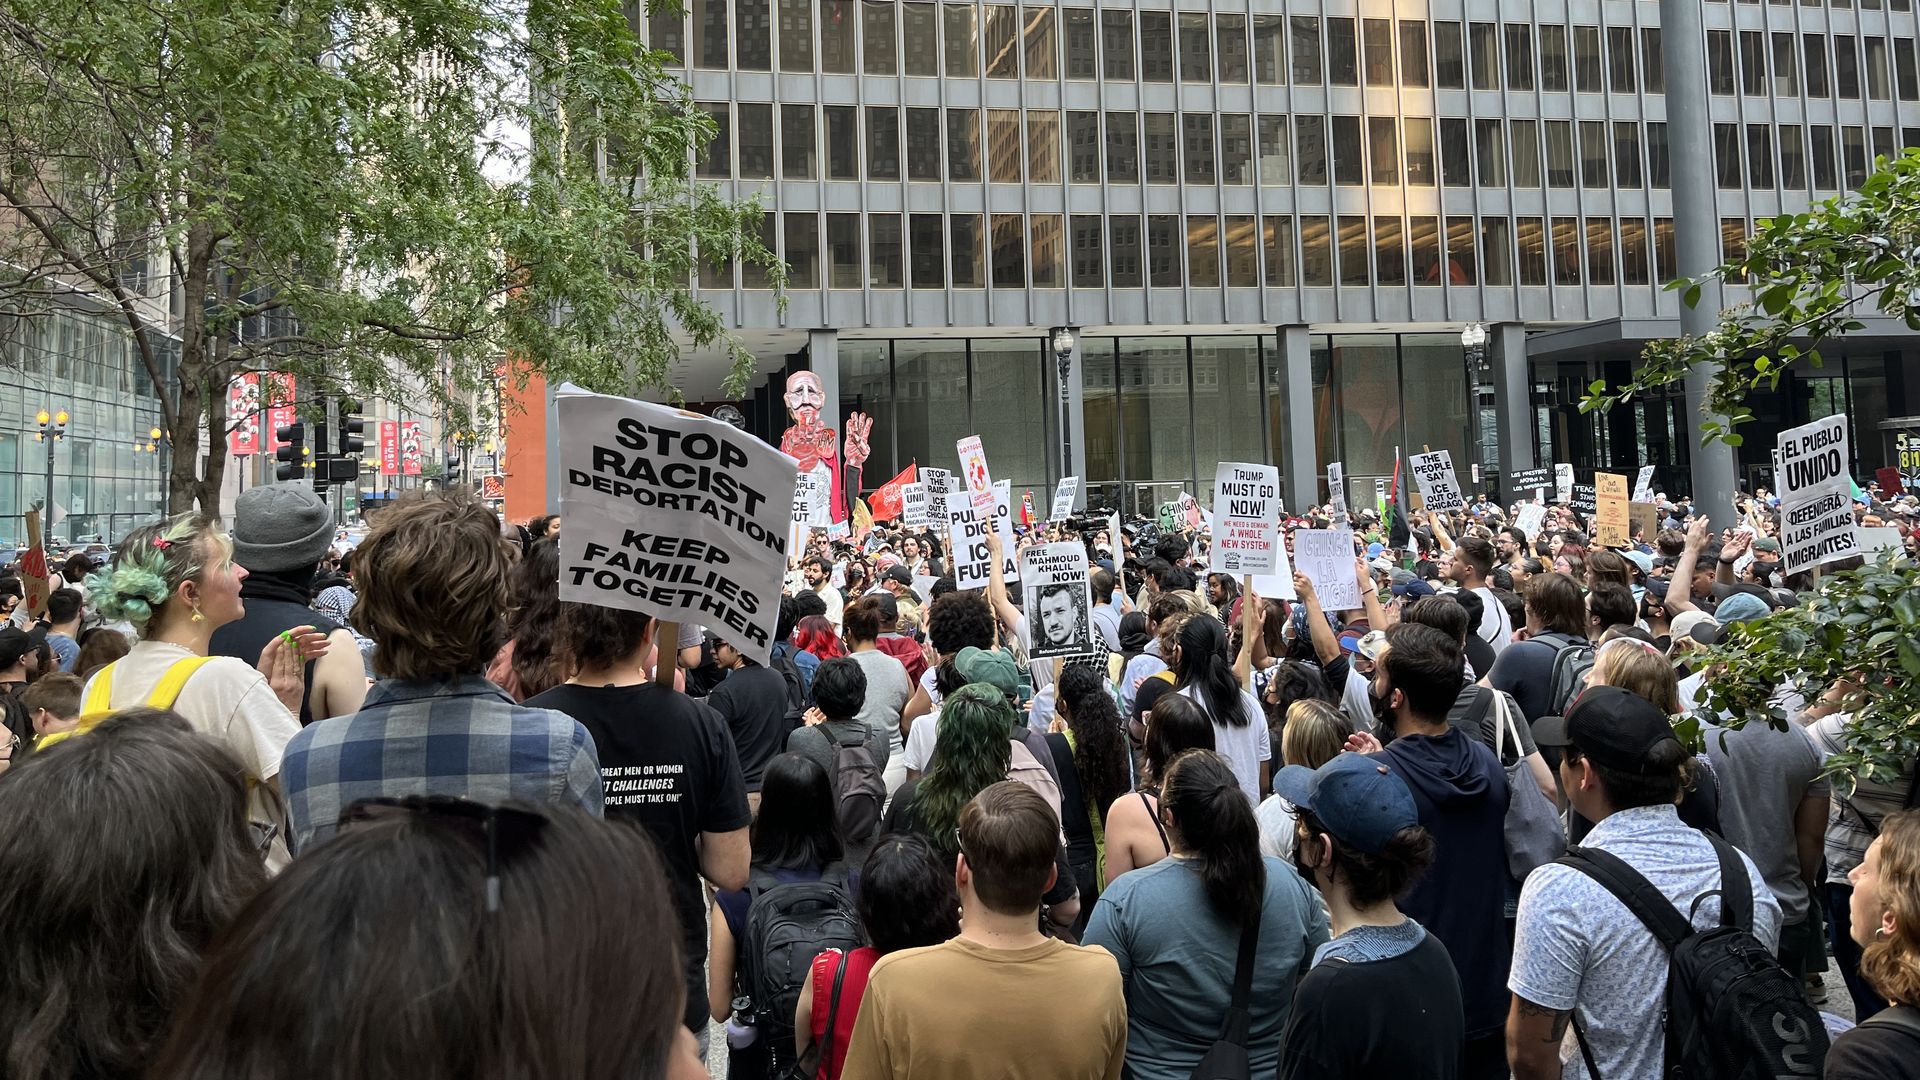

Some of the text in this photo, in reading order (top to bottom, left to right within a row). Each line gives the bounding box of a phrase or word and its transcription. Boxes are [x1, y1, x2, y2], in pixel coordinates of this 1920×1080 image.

[615, 417, 748, 470] STOP
[1782, 439, 1800, 463] ¡EL
[1802, 425, 1842, 454] PUEBLO
[1420, 454, 1440, 464] THE
[1414, 461, 1451, 474] PEOPLE
[1786, 448, 1841, 492] UNIDO
[927, 470, 946, 478] STOP
[1234, 469, 1264, 482] TRUMP
[1426, 471, 1445, 482] SAY
[592, 445, 766, 517] RACIST
[930, 478, 944, 486] THE
[795, 490, 807, 498] AY
[928, 486, 948, 494] RAIDS
[1222, 482, 1274, 498] MUST GO
[1431, 484, 1450, 494] ICE
[906, 493, 924, 503] UNI
[932, 496, 946, 506] ICE
[1427, 492, 1458, 503] OUT OF
[568, 468, 786, 555] DEPORTATION
[792, 502, 808, 512] CE
[928, 504, 941, 512] OUT
[1160, 499, 1200, 516] CHINGA
[1230, 500, 1265, 516] NOW!
[1426, 500, 1463, 511] CHICAGO
[1790, 492, 1842, 526] DEFENDERÁ
[792, 513, 810, 522] UT
[1230, 529, 1262, 539] A WHOLE
[1786, 512, 1851, 546] A LAS FAMILIAS
[620, 528, 731, 564] KEEP
[1222, 540, 1270, 550] NEW SYSTEM!
[1304, 532, 1351, 558] CHINGA
[1787, 532, 1855, 569] MIGRANTES!
[969, 542, 989, 562] IC
[1026, 549, 1048, 558] FREE
[1029, 554, 1080, 566] MAHMOUD
[958, 558, 1016, 582] FUEA
[1038, 564, 1074, 572] KHALIL
[1317, 558, 1337, 583] LA
[582, 542, 760, 615] FAMILIES
[1052, 571, 1085, 582] NOW!
[568, 566, 769, 648] TOGETHER
[601, 765, 683, 776] GREAT MEN OR WOMEN
[612, 778, 674, 792] CHALLENGES
[605, 796, 622, 805] OPLE
[624, 794, 645, 804] MUST
[647, 794, 664, 803] TAKE
